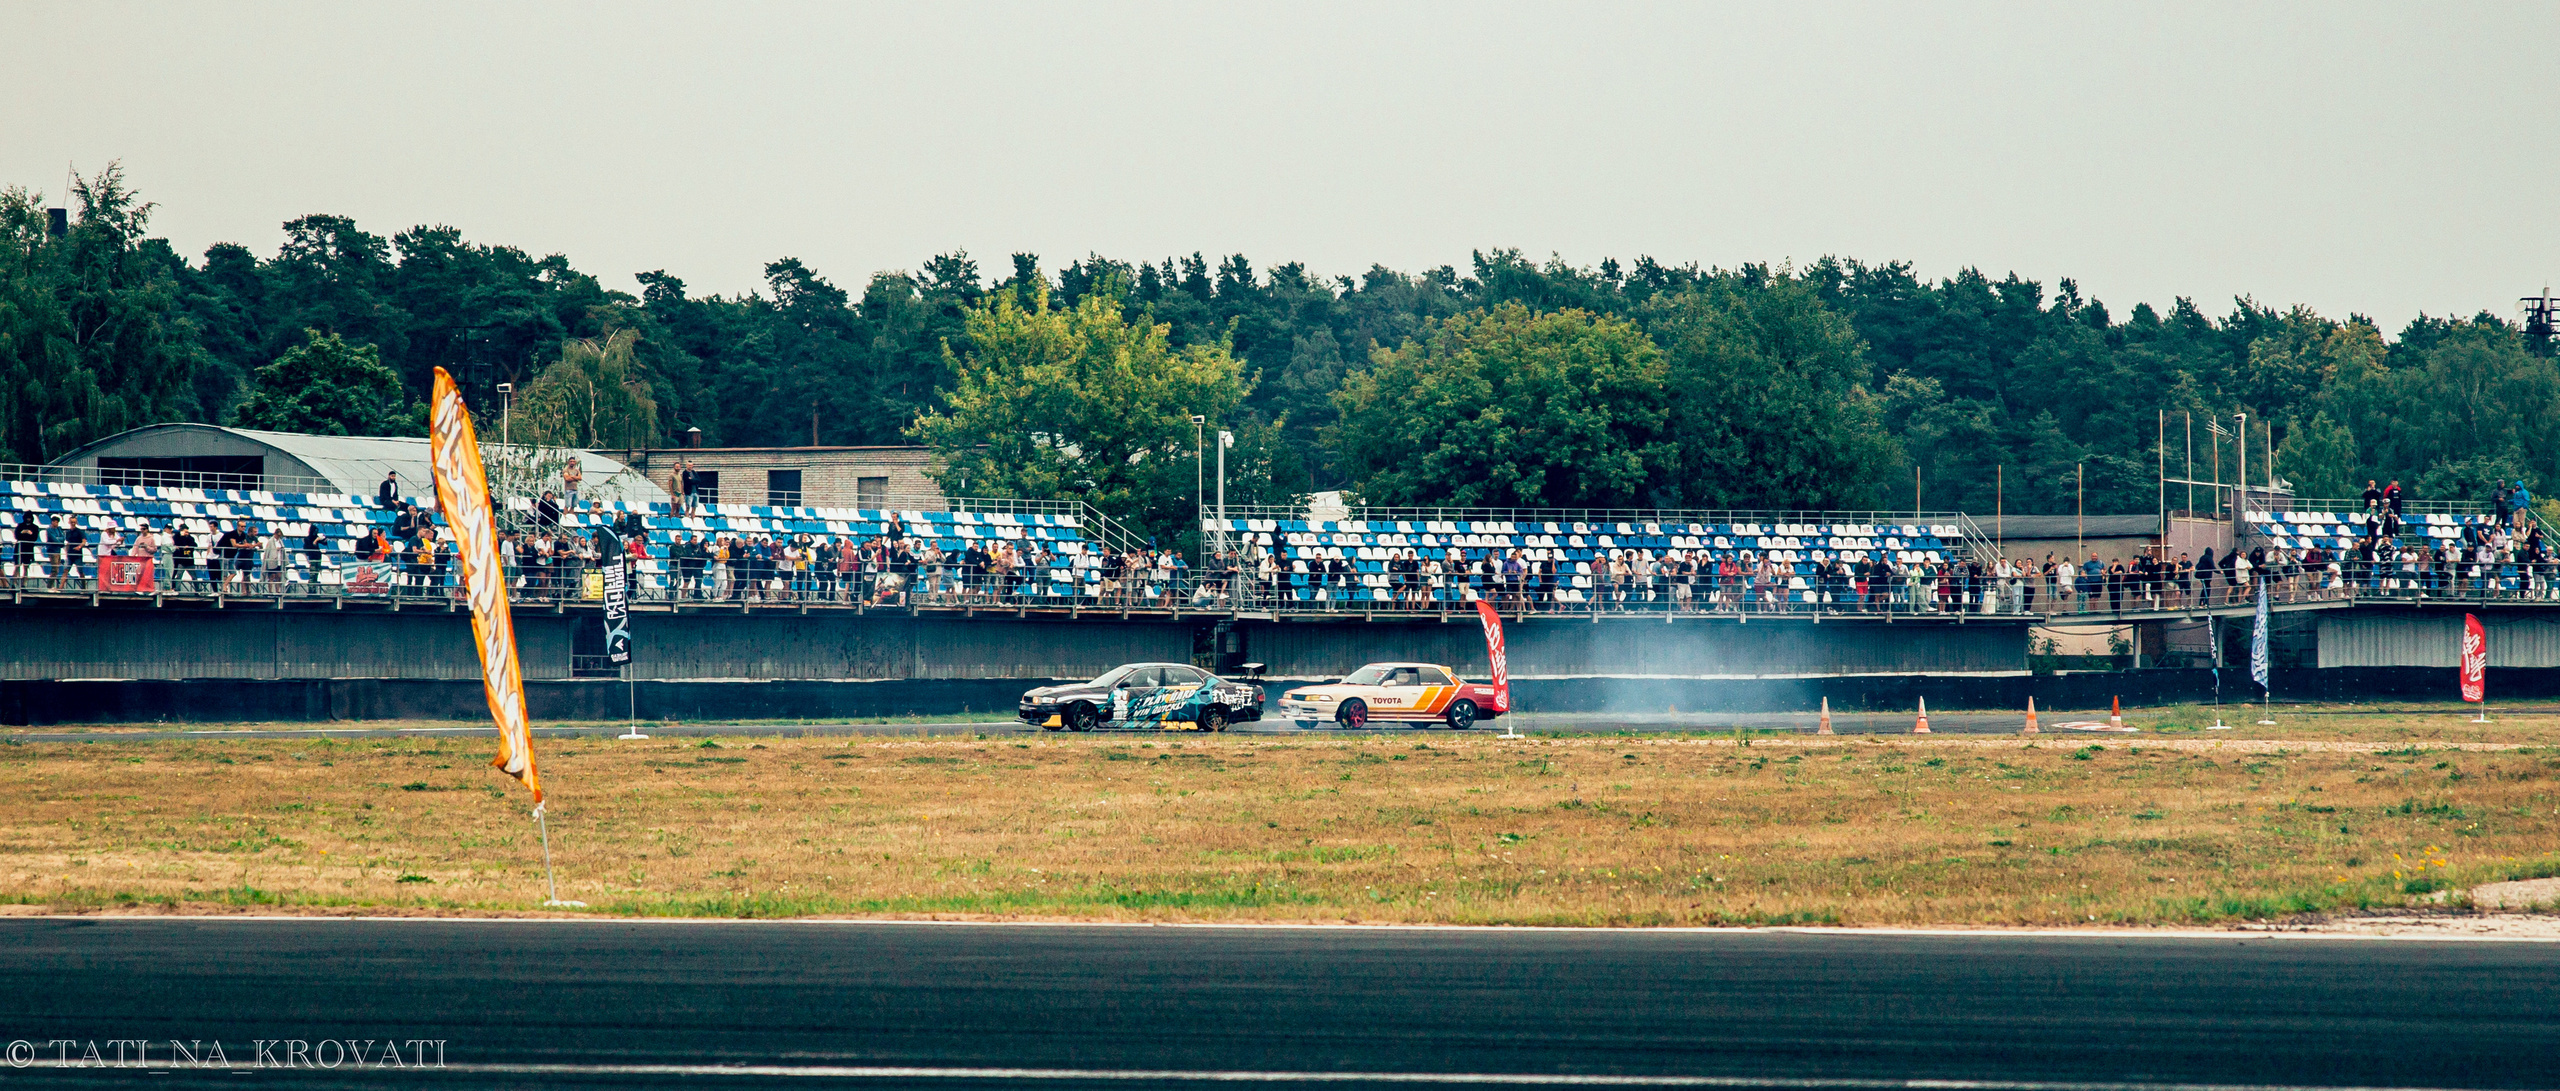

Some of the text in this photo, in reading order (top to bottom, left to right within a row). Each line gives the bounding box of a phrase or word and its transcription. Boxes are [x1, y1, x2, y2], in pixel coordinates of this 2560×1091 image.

[1143, 694, 1167, 707] PLAY
[1170, 689, 1196, 702] HARD
[1133, 701, 1188, 717] WIN QUICKLY
